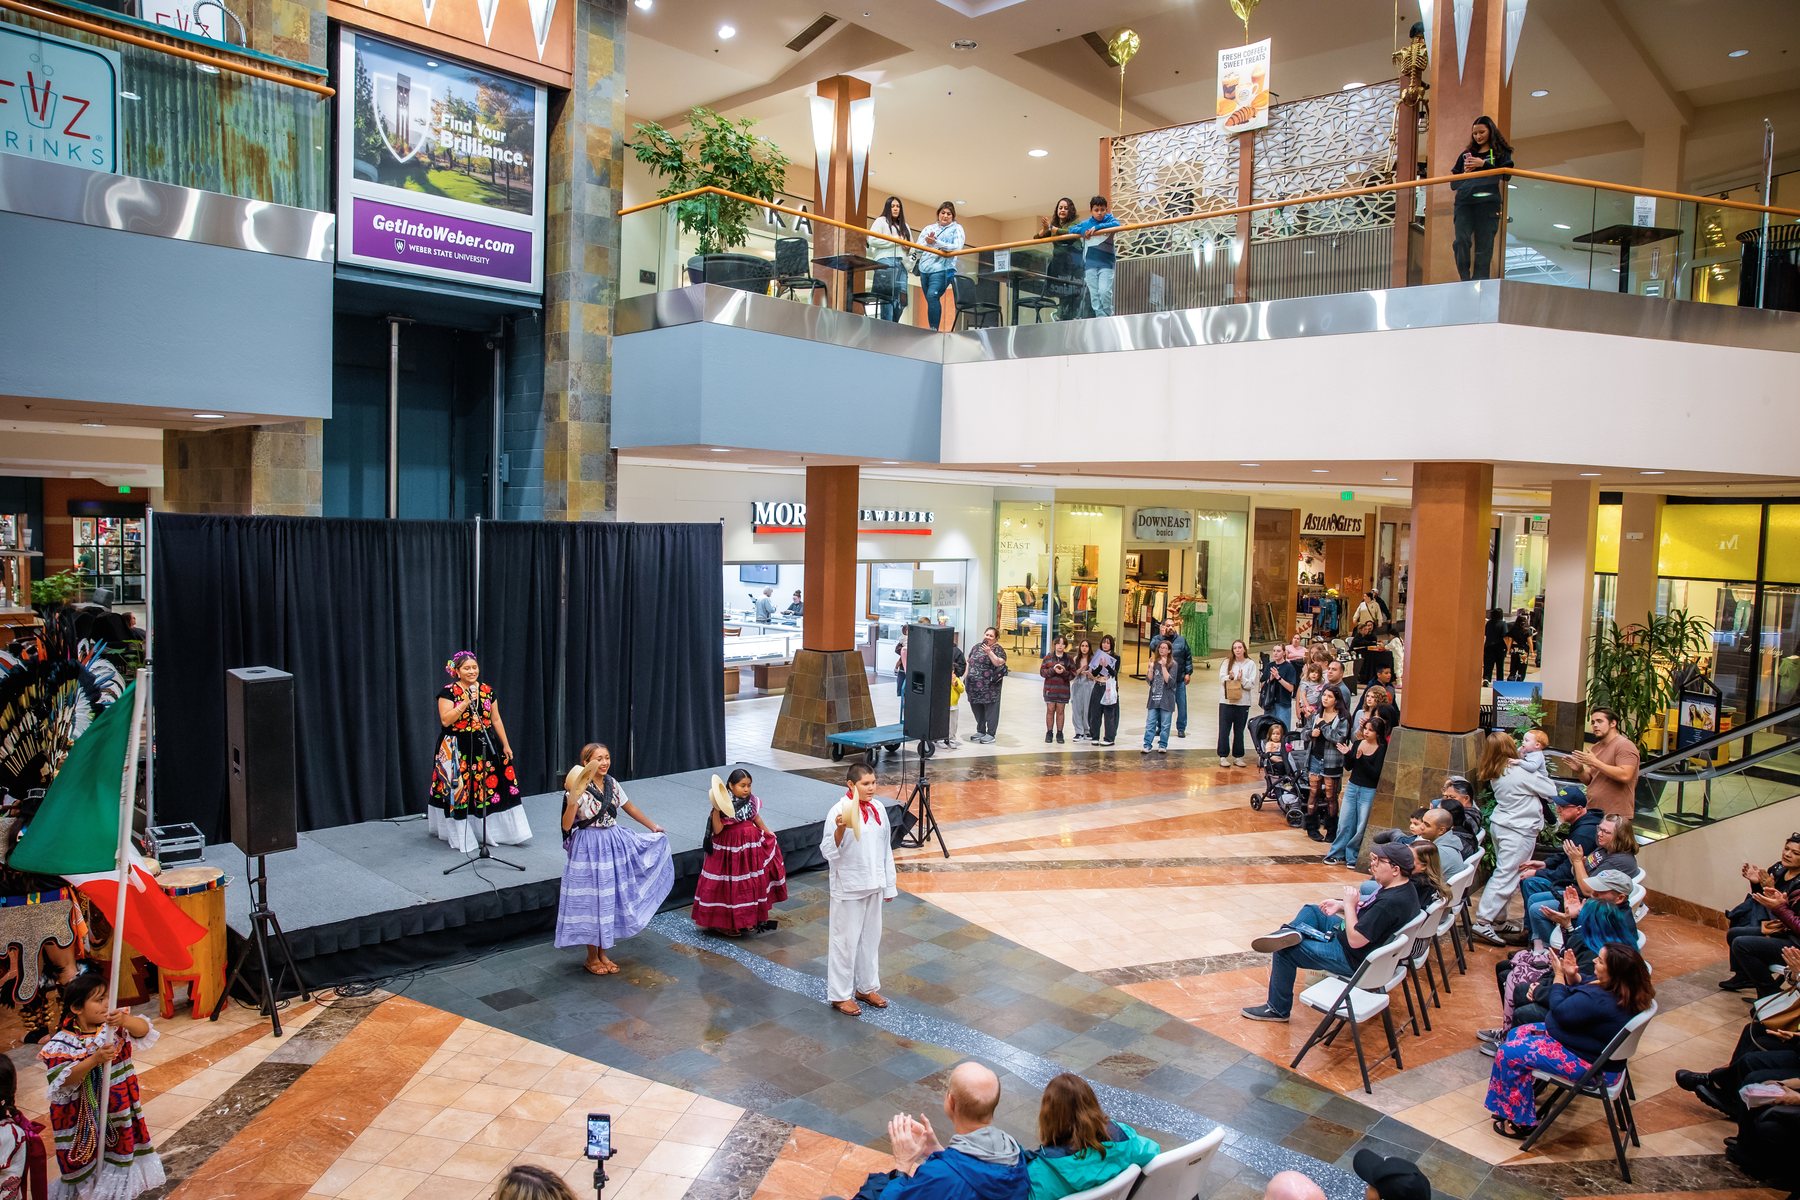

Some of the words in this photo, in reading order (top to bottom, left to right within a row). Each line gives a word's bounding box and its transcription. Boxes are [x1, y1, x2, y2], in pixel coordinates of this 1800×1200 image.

[1222, 53, 1242, 62] FRESH
[1243, 46, 1264, 58] COFFEE
[1223, 60, 1243, 69] SWEET
[1245, 53, 1266, 64] TREATS
[441, 112, 472, 134] Find
[476, 121, 507, 142] Your
[440, 129, 528, 167] Brilliance.
[372, 214, 515, 254] GetIntoWeber.com
[409, 244, 432, 255] WEBER
[433, 249, 453, 258] STATE
[453, 252, 490, 265] UNIVERSITY
[858, 510, 935, 523] EWELERS
